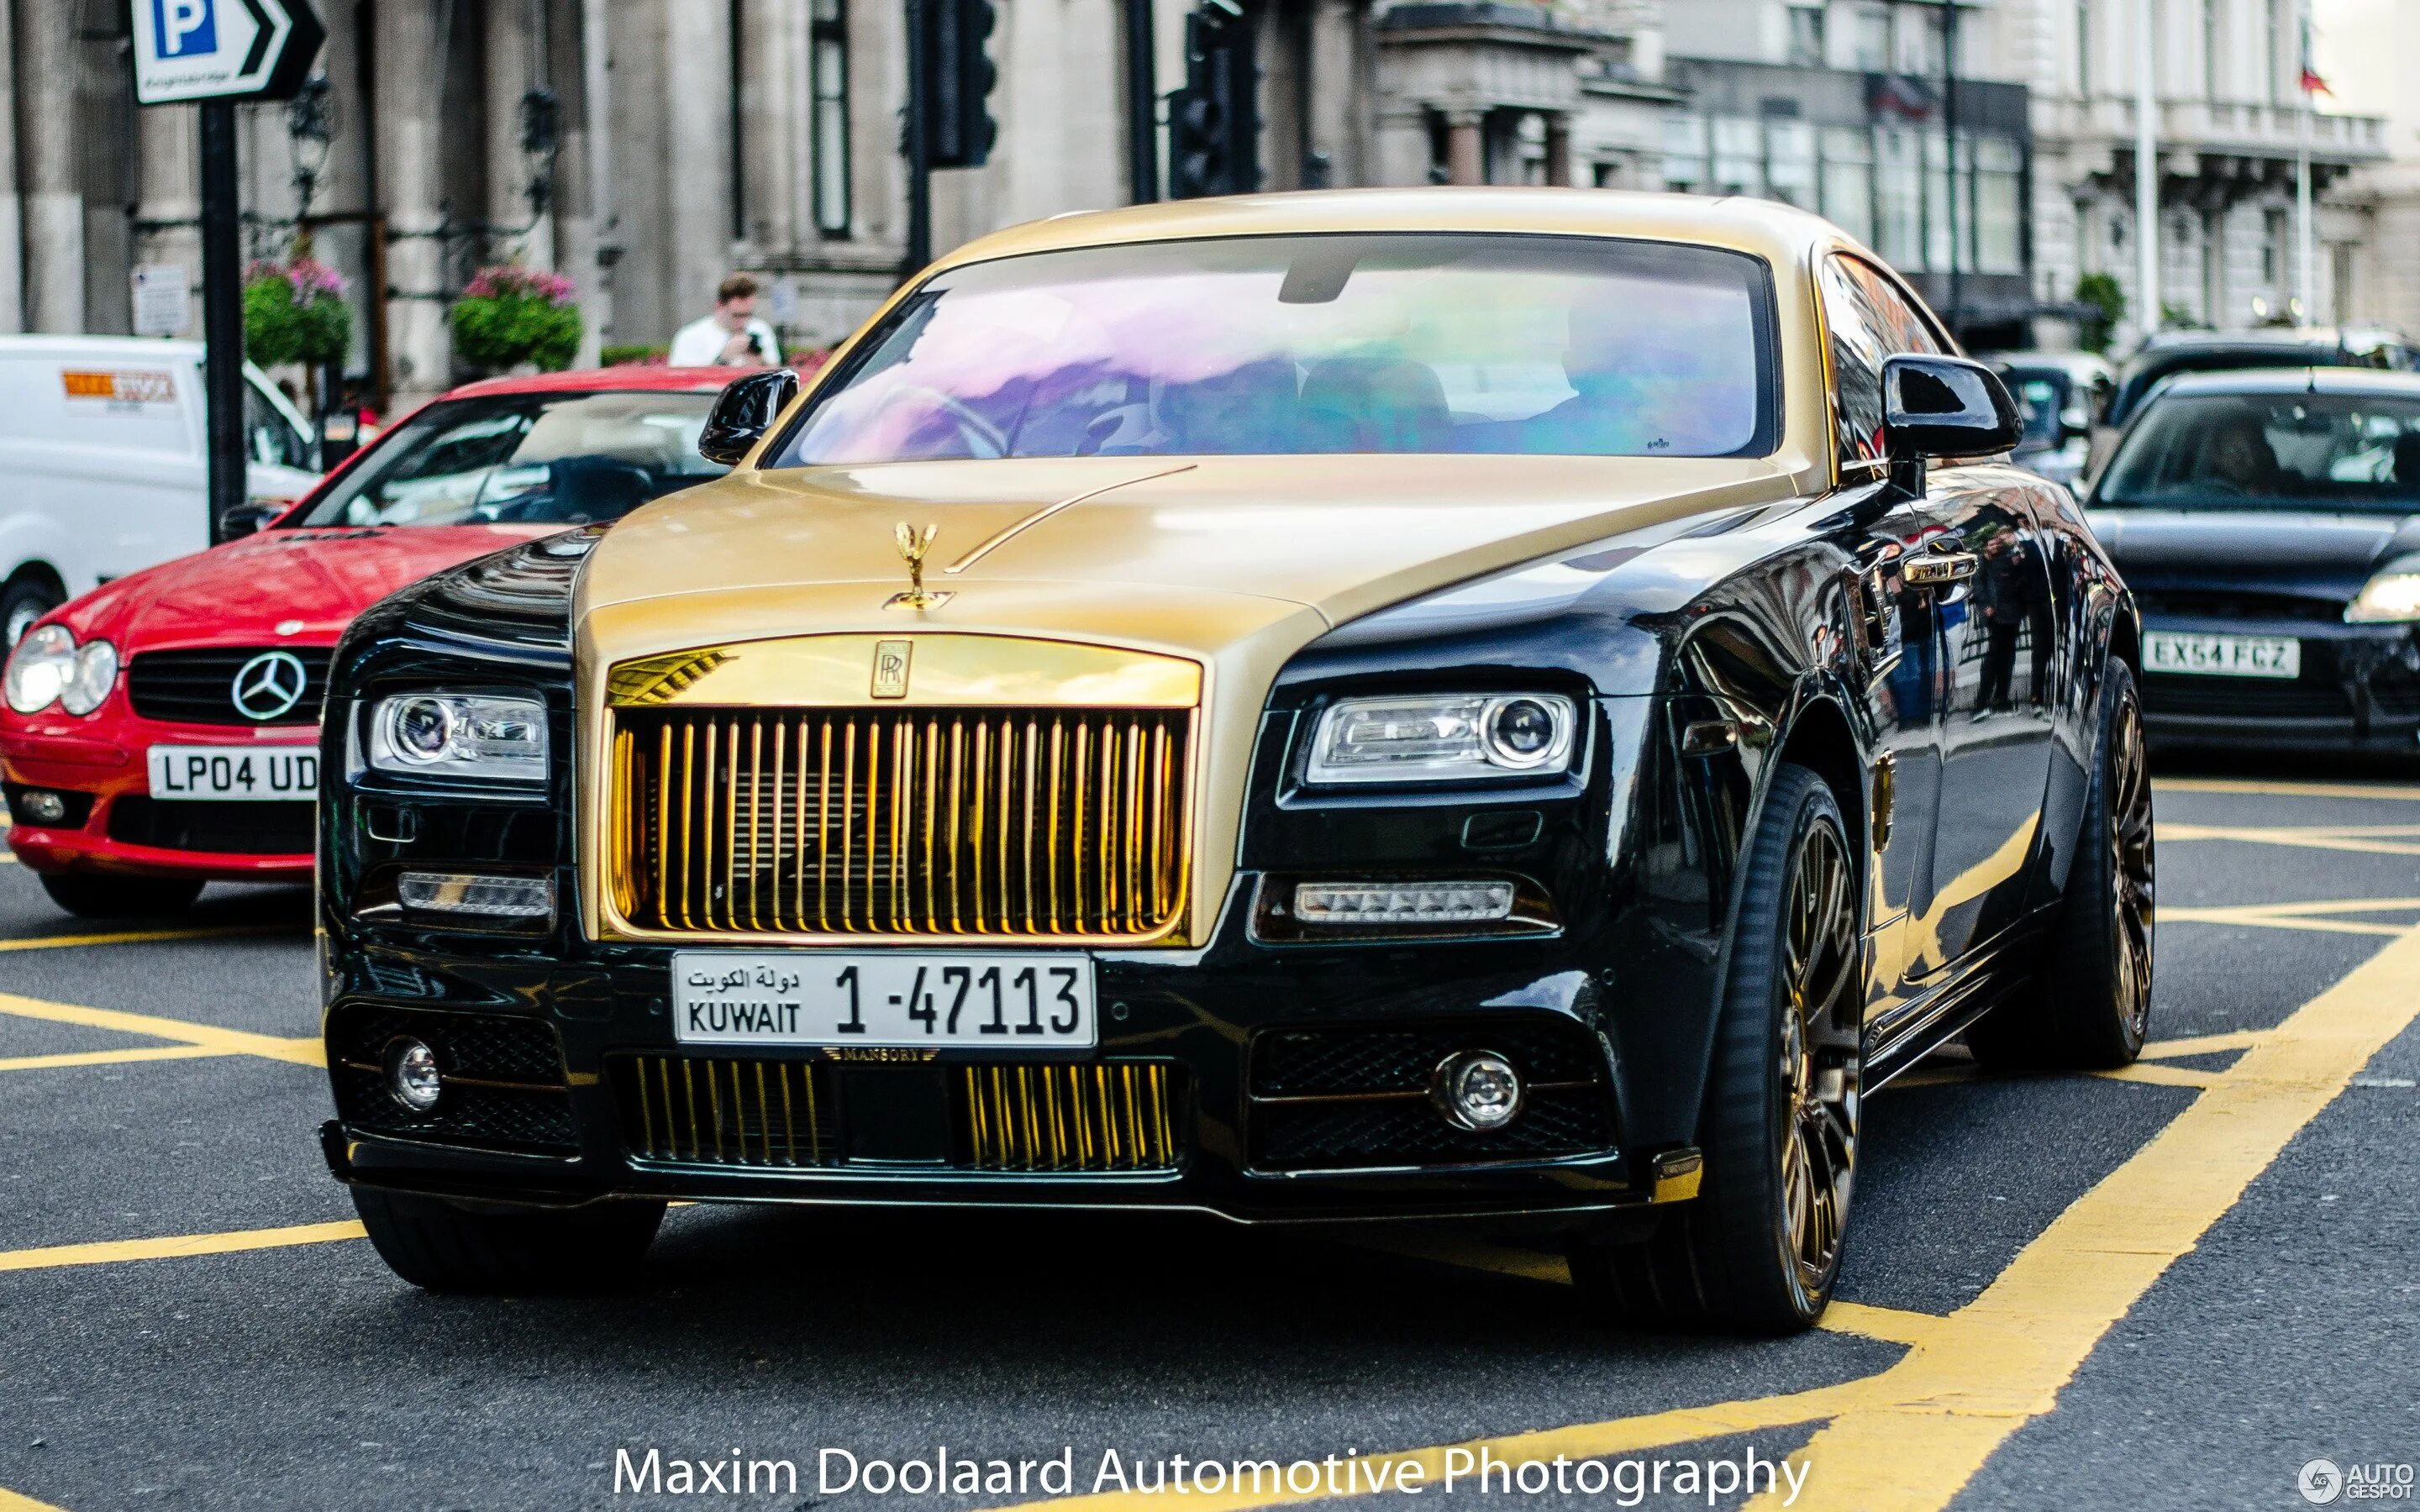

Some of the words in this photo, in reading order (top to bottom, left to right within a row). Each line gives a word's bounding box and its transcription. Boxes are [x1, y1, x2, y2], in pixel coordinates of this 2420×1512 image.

[164, 0, 208, 55] P
[165, 756, 255, 791] LP04
[688, 965, 750, 995] الكويت
[756, 965, 800, 993] دولة
[689, 1002, 800, 1033] KUWAIT
[844, 1047, 918, 1061] MANSORY
